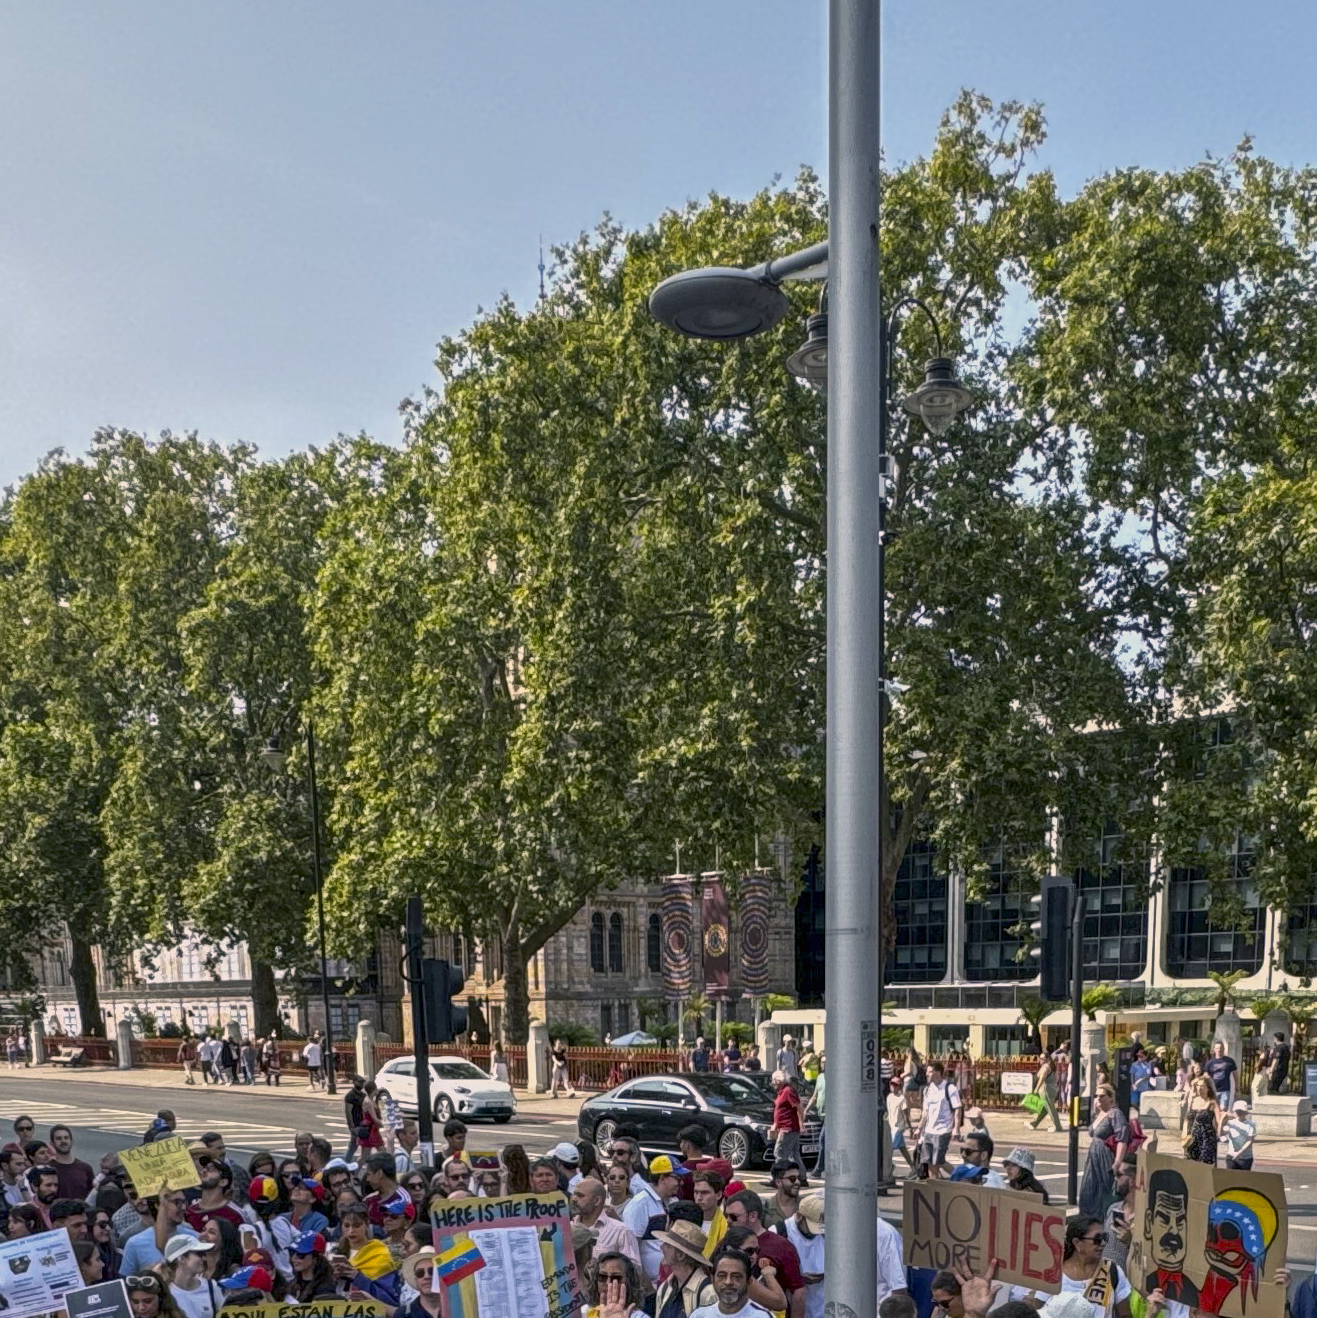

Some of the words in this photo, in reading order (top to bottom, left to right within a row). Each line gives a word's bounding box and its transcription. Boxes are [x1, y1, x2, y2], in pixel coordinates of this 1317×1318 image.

[434, 1204, 472, 1229] HERE
[476, 1204, 494, 1222] IS
[495, 1201, 522, 1219] THE
[525, 1197, 567, 1219] PROOF
[912, 1189, 981, 1243] NO
[909, 1239, 981, 1273] MORE
[988, 1206, 1064, 1284] LIES
[546, 1289, 560, 1304] IS
